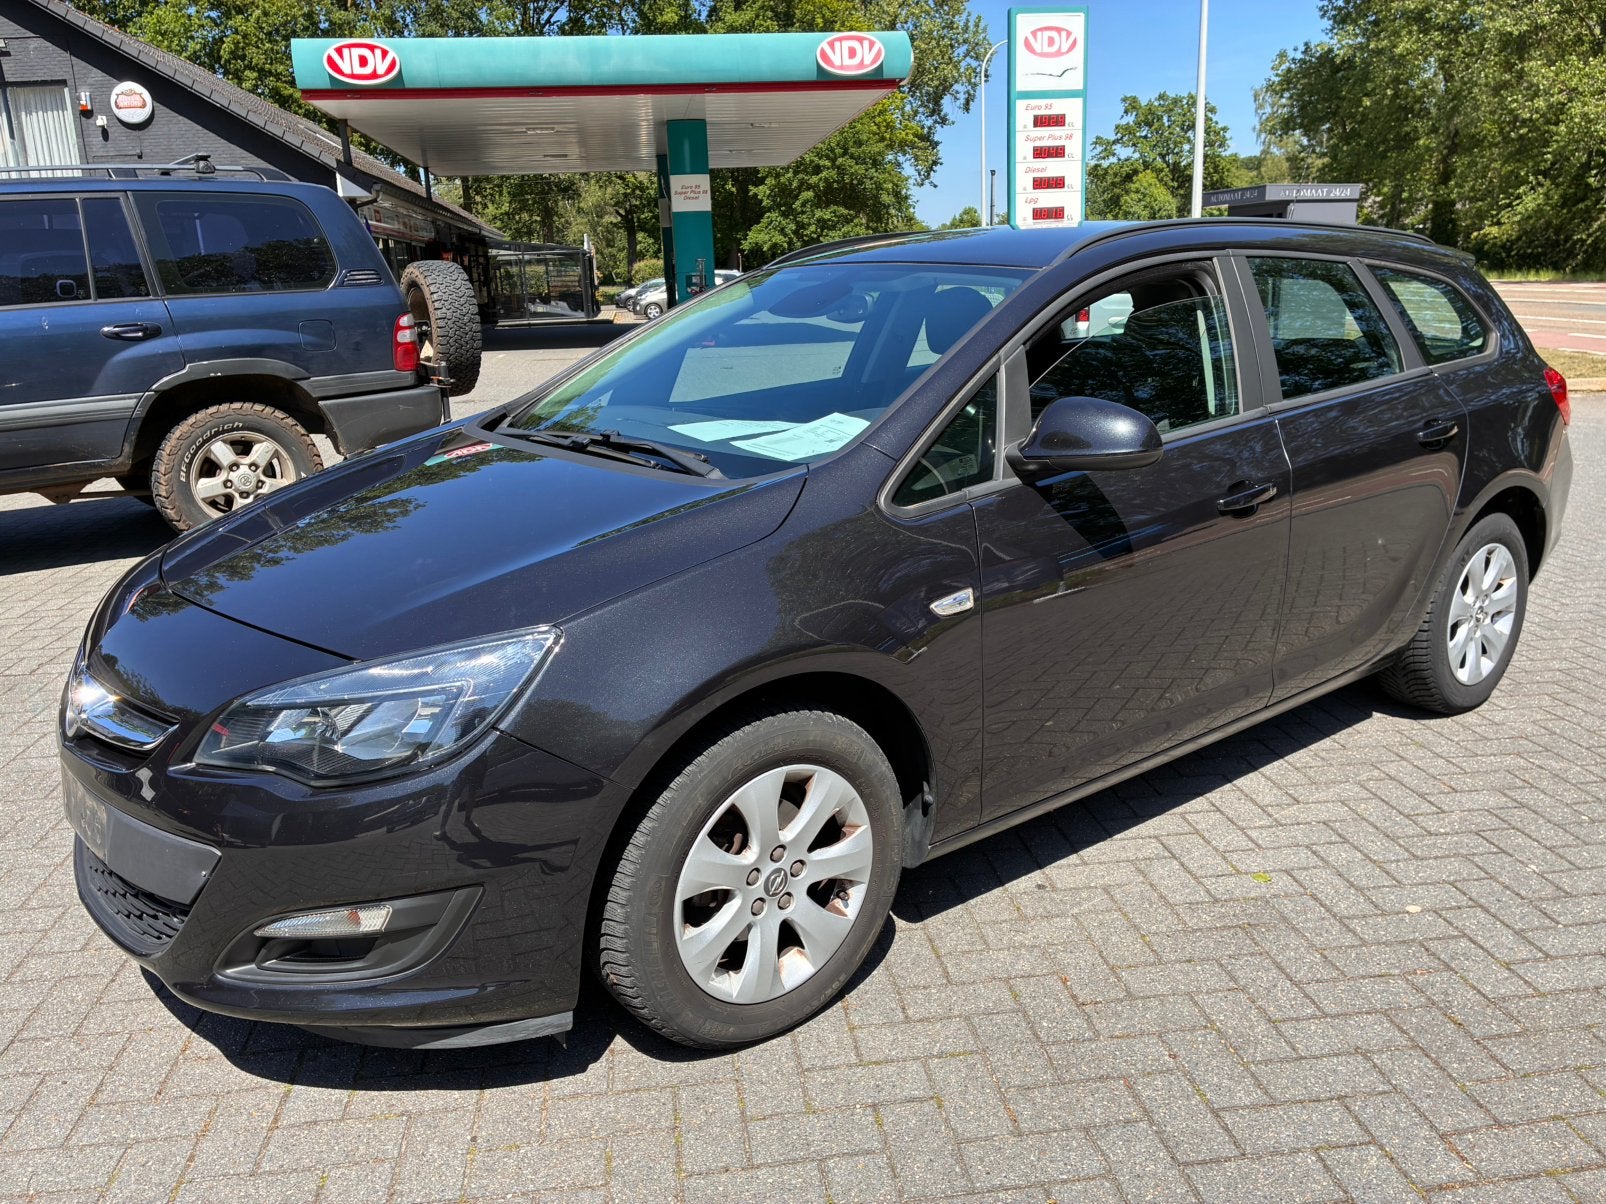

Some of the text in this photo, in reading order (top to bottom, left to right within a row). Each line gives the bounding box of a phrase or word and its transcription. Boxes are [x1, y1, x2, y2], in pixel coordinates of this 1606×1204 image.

[821, 39, 881, 66] VDV
[1026, 30, 1076, 53] VDV
[326, 47, 395, 75] VDV
[1025, 102, 1053, 111] Euro 95
[1024, 132, 1074, 143] Super Plus 98
[1025, 166, 1047, 174] Diesel
[179, 421, 243, 483] BFGoodrich
